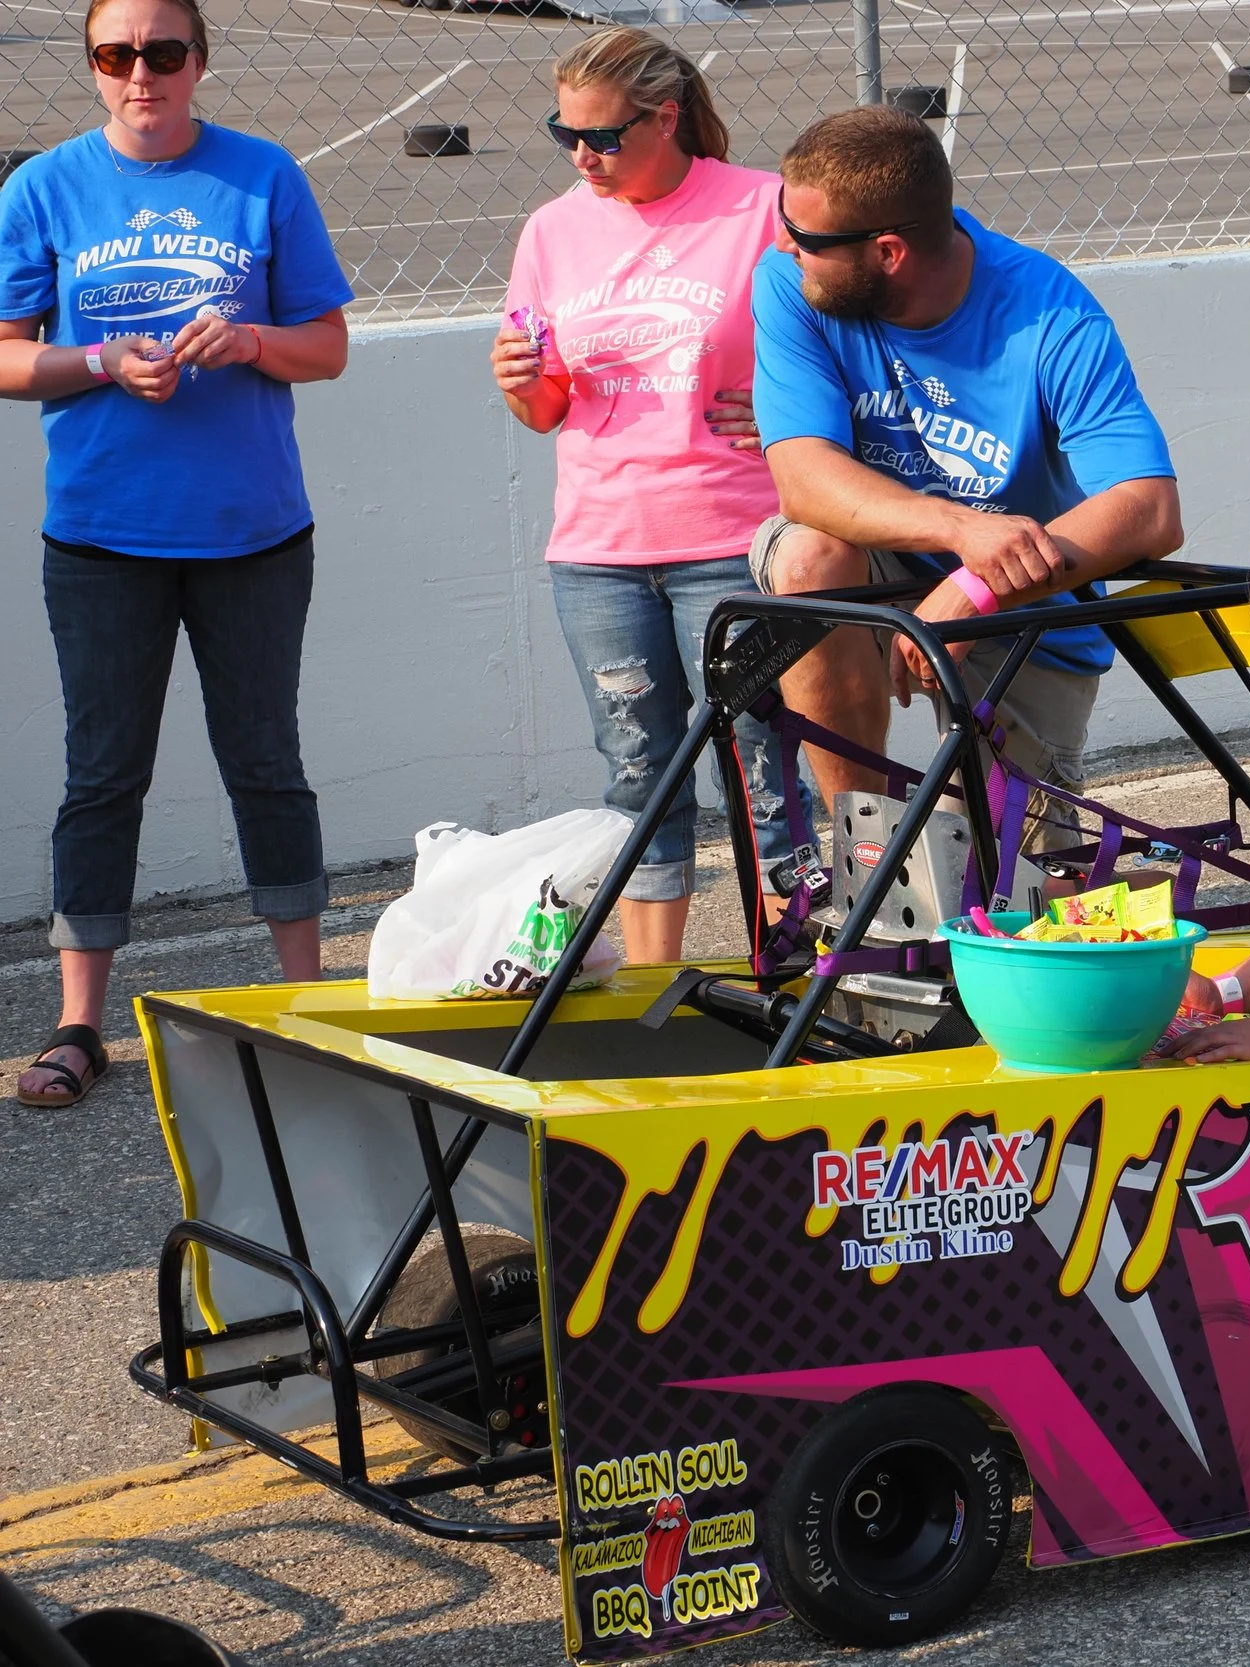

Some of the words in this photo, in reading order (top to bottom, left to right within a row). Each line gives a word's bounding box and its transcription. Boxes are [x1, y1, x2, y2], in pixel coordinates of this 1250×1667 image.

[76, 236, 142, 277] MINI
[153, 234, 253, 273] WEDGE
[79, 281, 160, 310] RACING
[159, 275, 247, 300] FAMILY
[626, 276, 726, 314] WEDGE
[561, 328, 629, 363] ACING
[629, 316, 718, 347] FAMILY
[637, 375, 700, 393] RACING
[857, 847, 883, 859] KIRKE
[866, 1200, 940, 1236] ELITE
[947, 1191, 1029, 1227] GROUP
[842, 1236, 931, 1269] Dustin
[941, 1227, 1013, 1258] Kline
[578, 1455, 672, 1508] ROLLIN
[680, 1443, 744, 1488] SOUL
[969, 1447, 1005, 1548] Hoosier
[573, 1536, 644, 1572] KALAMAZOO
[691, 1515, 752, 1550] MICHIGAN
[804, 1491, 840, 1594] Hoosier
[596, 1590, 649, 1632] BBQ
[676, 1569, 757, 1618] JOINT
